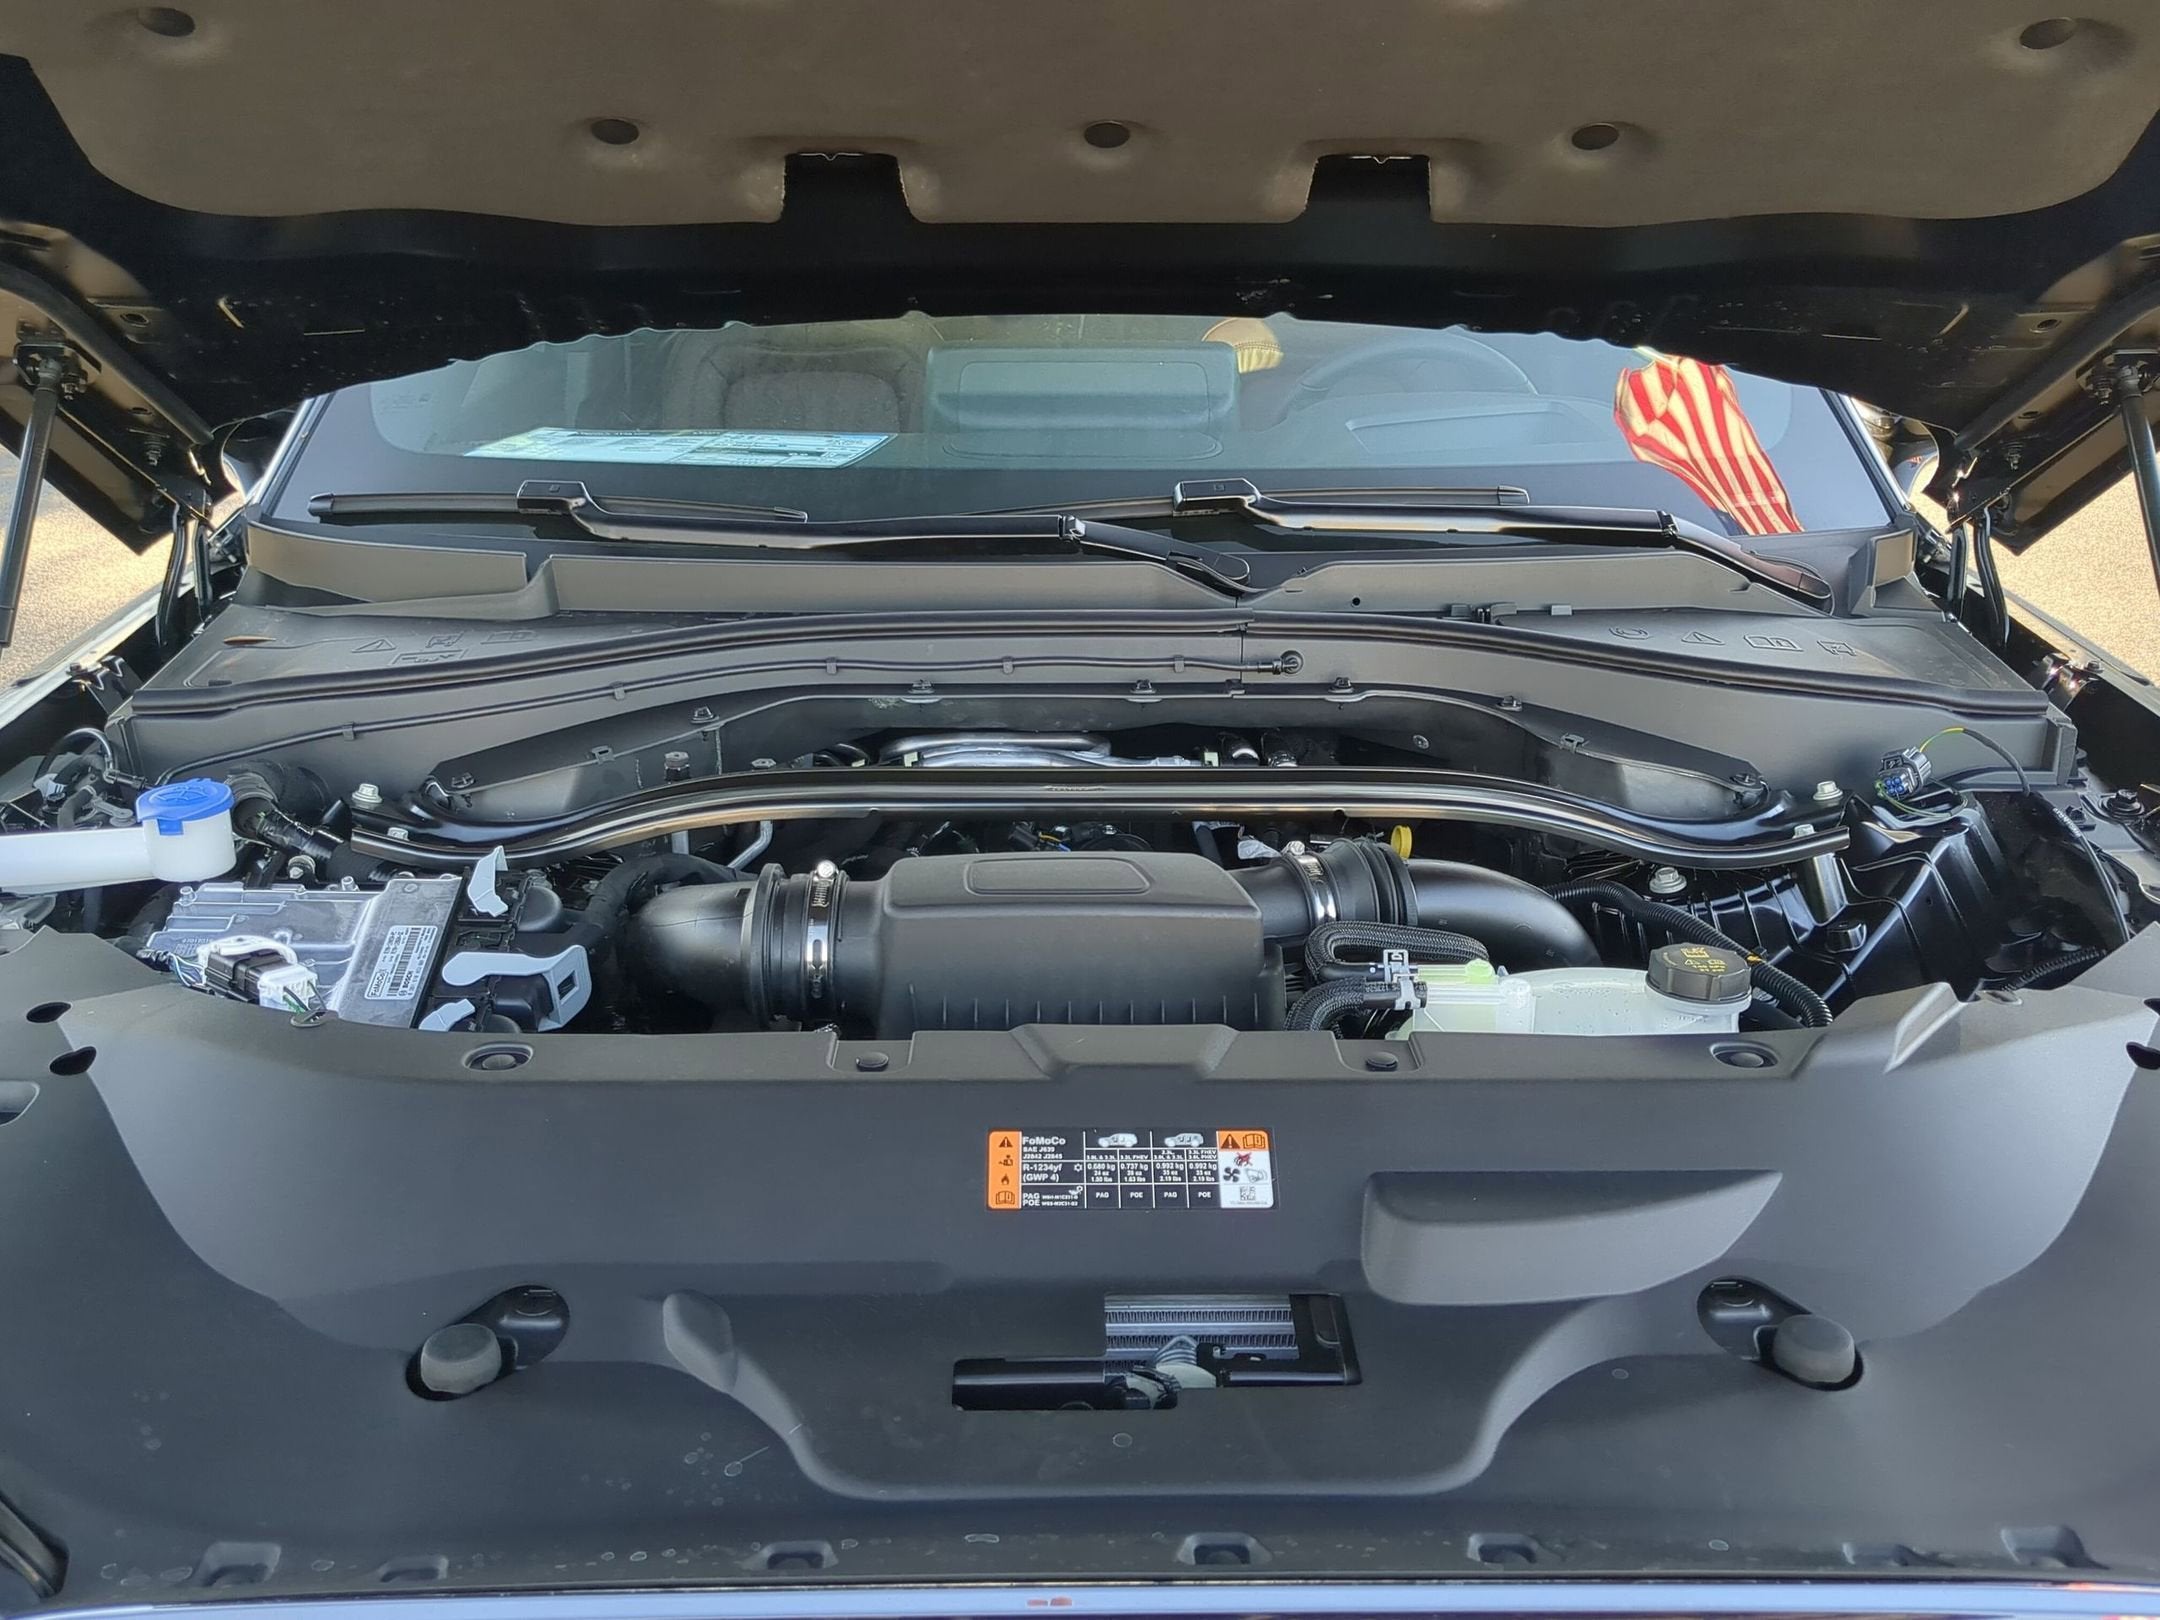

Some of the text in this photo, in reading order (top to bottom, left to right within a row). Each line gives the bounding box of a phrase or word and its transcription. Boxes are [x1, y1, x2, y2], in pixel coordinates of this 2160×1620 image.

[1023, 1136, 1066, 1145] FoMoCo
[1023, 1163, 1063, 1172] R-1234yf
[1106, 1163, 1116, 1171] kg
[1139, 1163, 1149, 1171] kg
[1175, 1163, 1184, 1171] kg
[1208, 1163, 1217, 1171] kg
[1023, 1173, 1059, 1182] (GWP 4)
